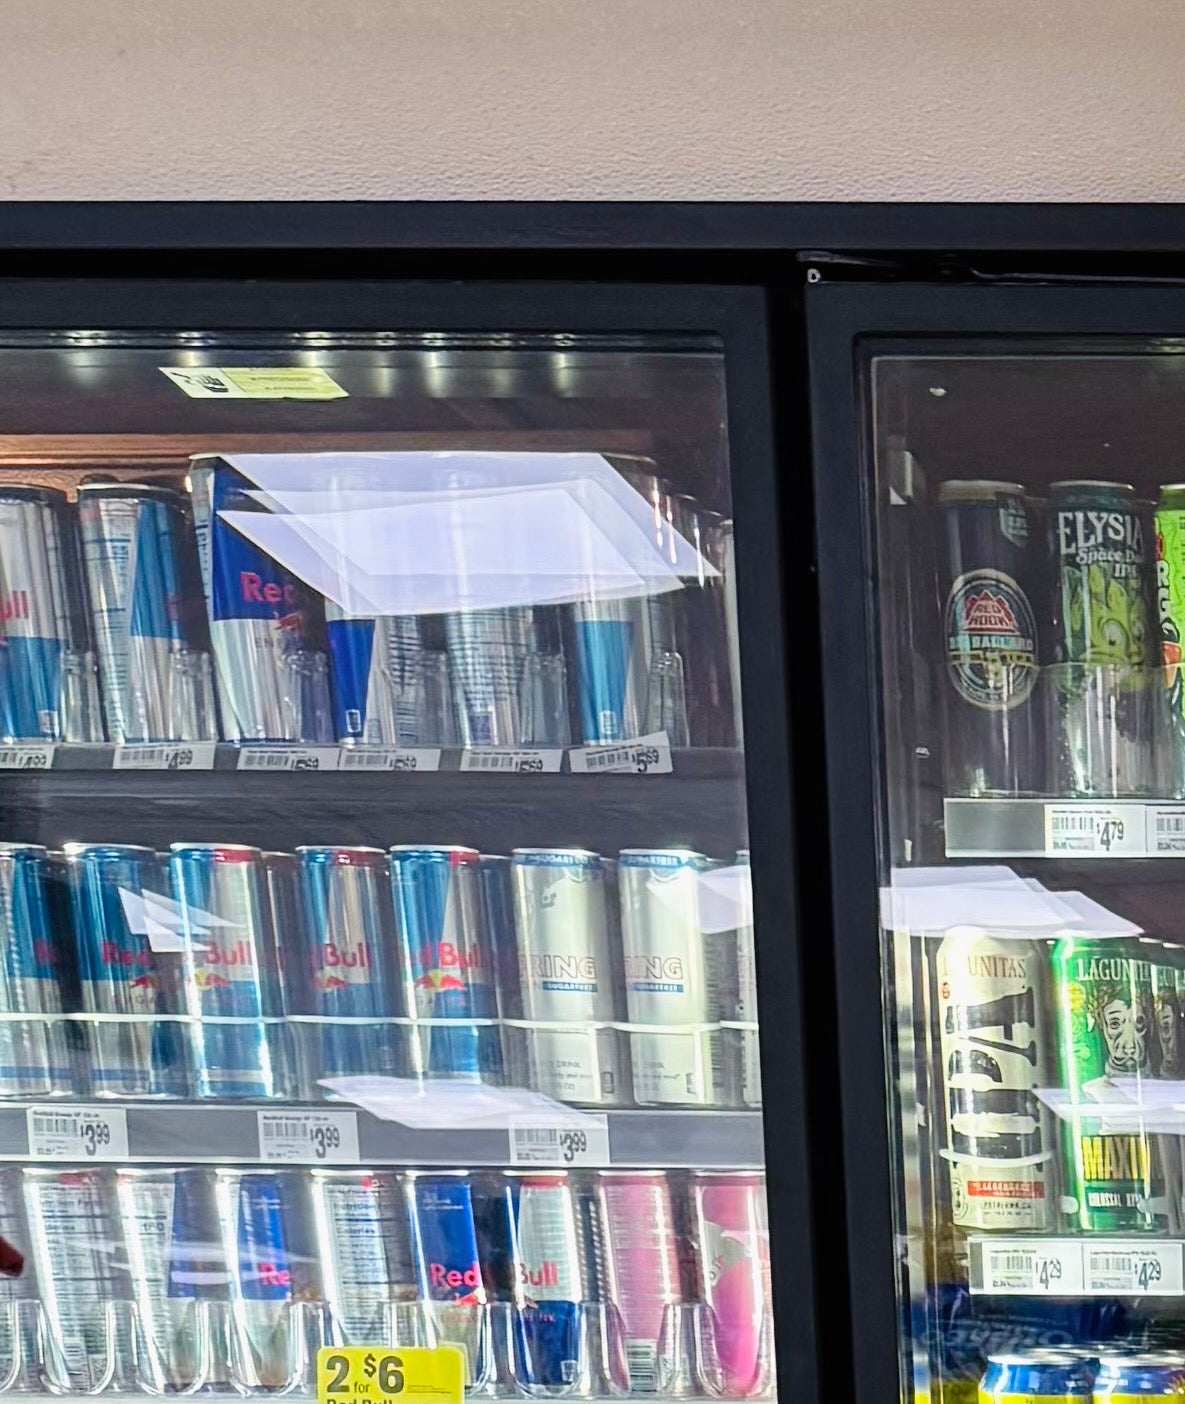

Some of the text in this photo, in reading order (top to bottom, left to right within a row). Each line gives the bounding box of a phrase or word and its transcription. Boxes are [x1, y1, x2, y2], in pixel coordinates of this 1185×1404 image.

[429, 1263, 479, 1287] Red
[326, 1356, 350, 1393] 2
[354, 1381, 370, 1393] for
